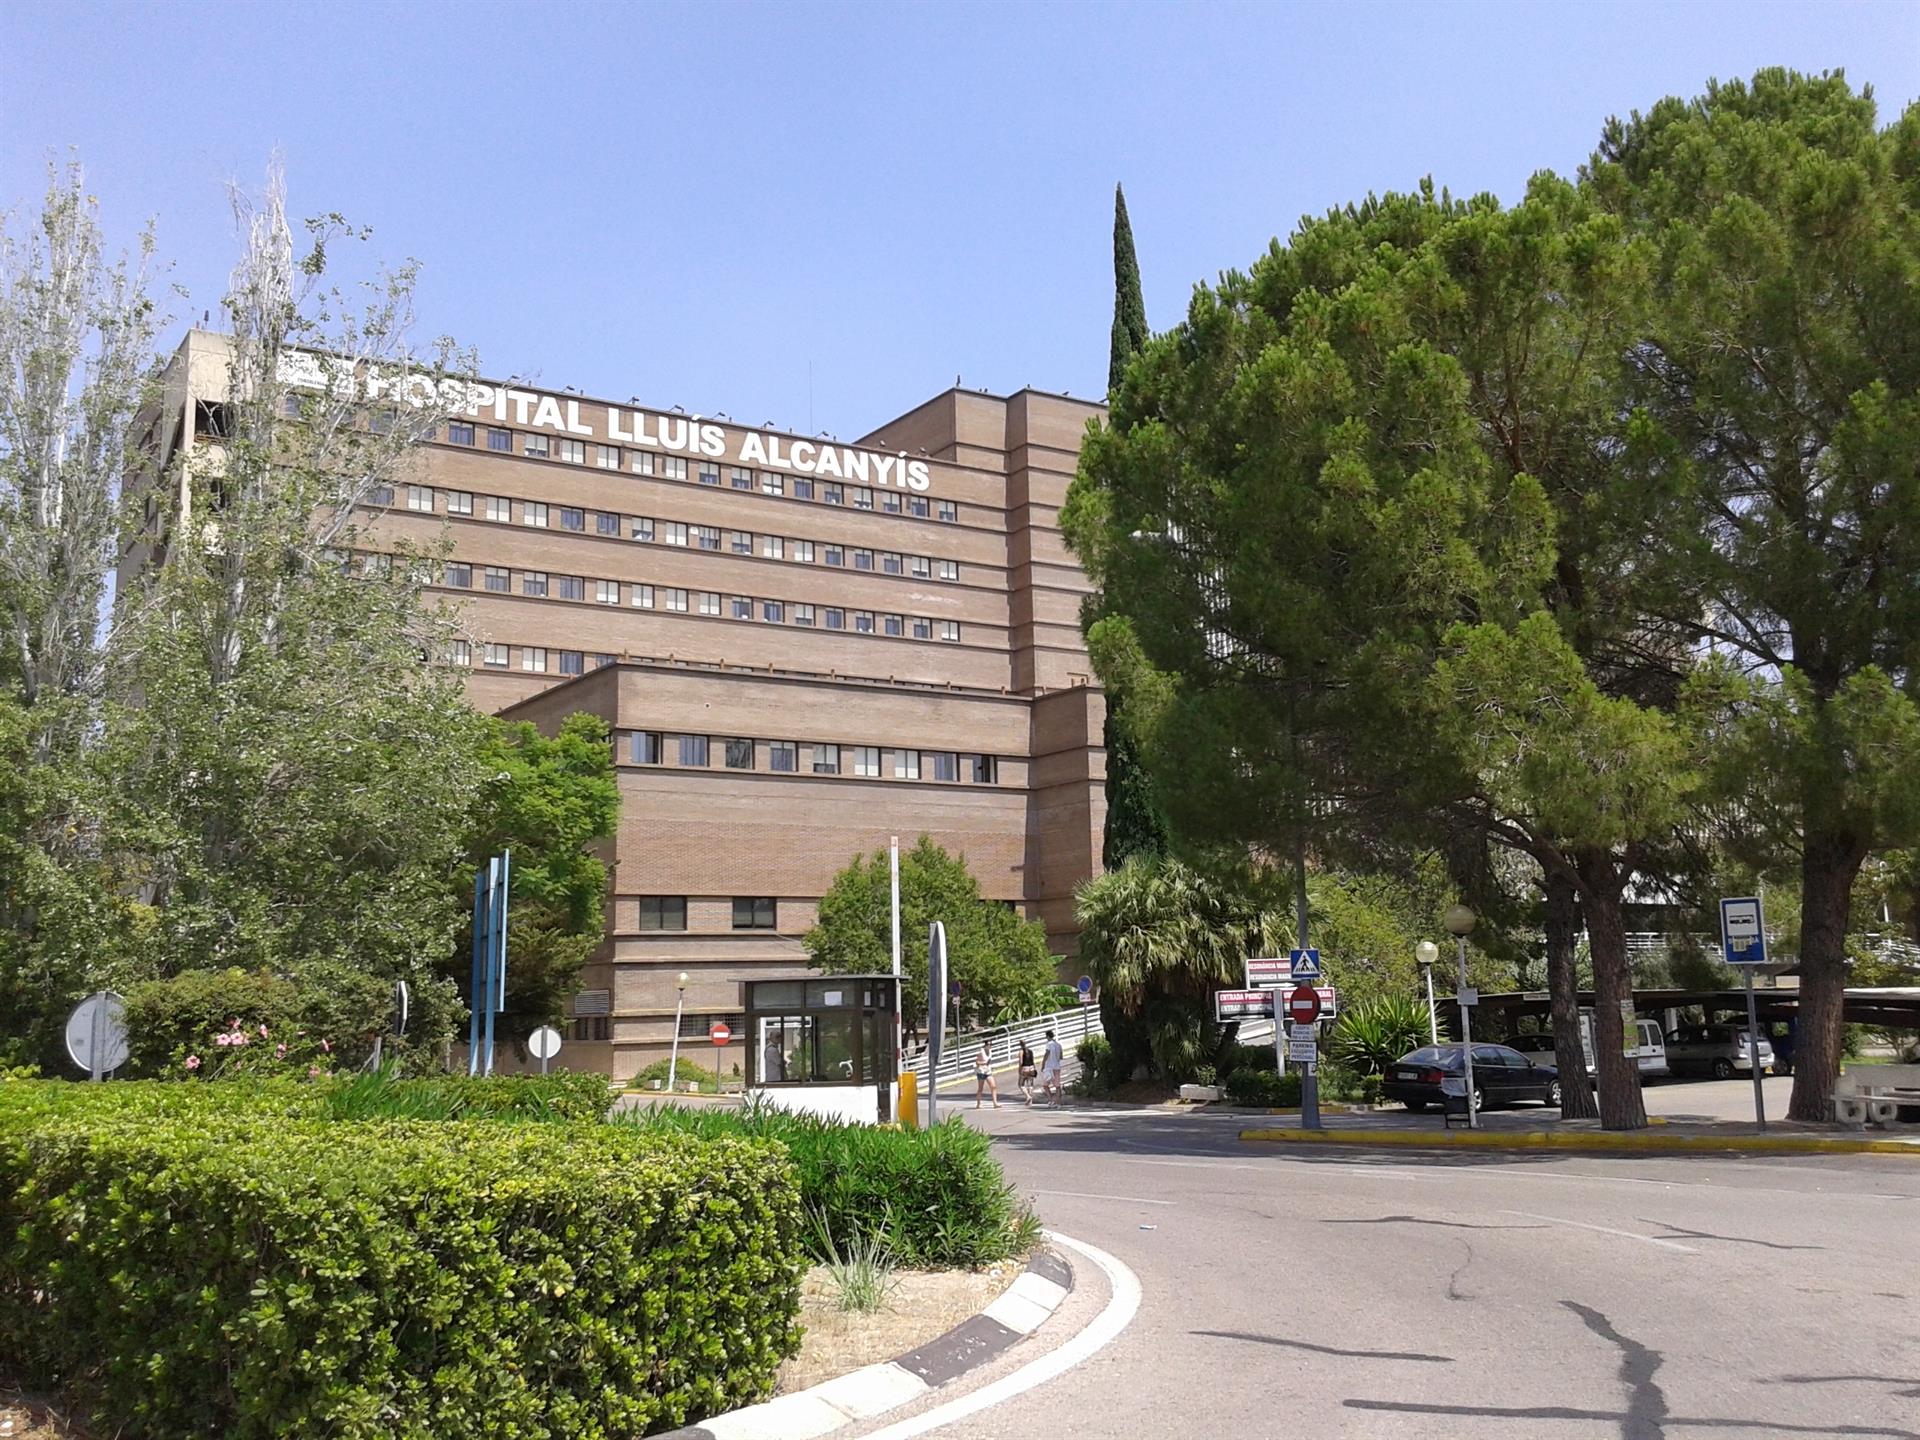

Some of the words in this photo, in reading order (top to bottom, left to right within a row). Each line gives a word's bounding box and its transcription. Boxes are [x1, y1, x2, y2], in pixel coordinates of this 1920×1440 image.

[366, 363, 594, 434] HOSPITAL
[607, 408, 726, 458] LLUÍS
[739, 432, 931, 491] ALCANYÍS
[1219, 993, 1244, 1001] ENTRADA
[1245, 992, 1273, 1000] PRINCIPAL
[1220, 1004, 1245, 1012] ENTRADA
[1246, 1003, 1273, 1011] PRINCIPAL
